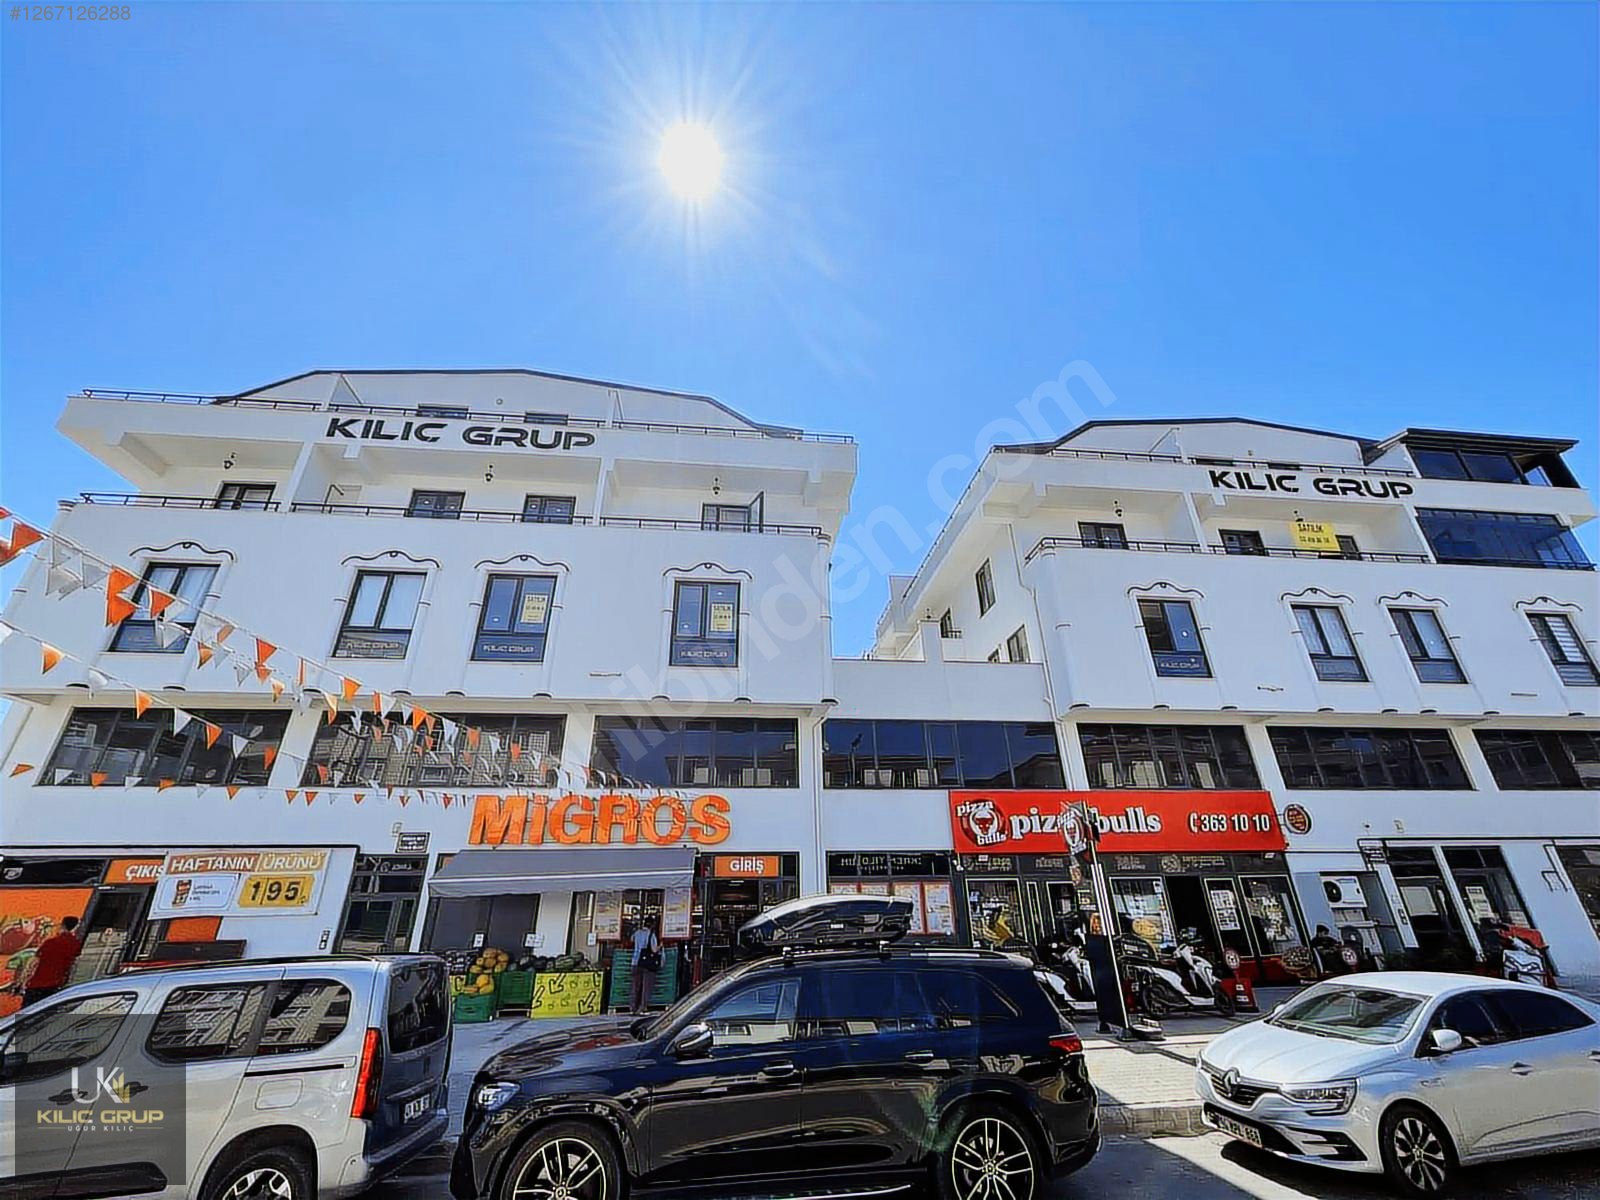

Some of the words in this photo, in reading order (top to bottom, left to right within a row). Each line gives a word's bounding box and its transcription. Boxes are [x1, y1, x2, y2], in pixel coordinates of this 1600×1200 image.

[462, 426, 595, 450] GRUP
[1313, 477, 1414, 498] GRUP
[1091, 807, 1162, 833] bulls
[1201, 814, 1227, 832] 363
[1232, 814, 1249, 832] 10
[1253, 814, 1270, 832] 10
[171, 856, 255, 873] HAFTANIN
[264, 853, 321, 870] ÜRÜNÜ
